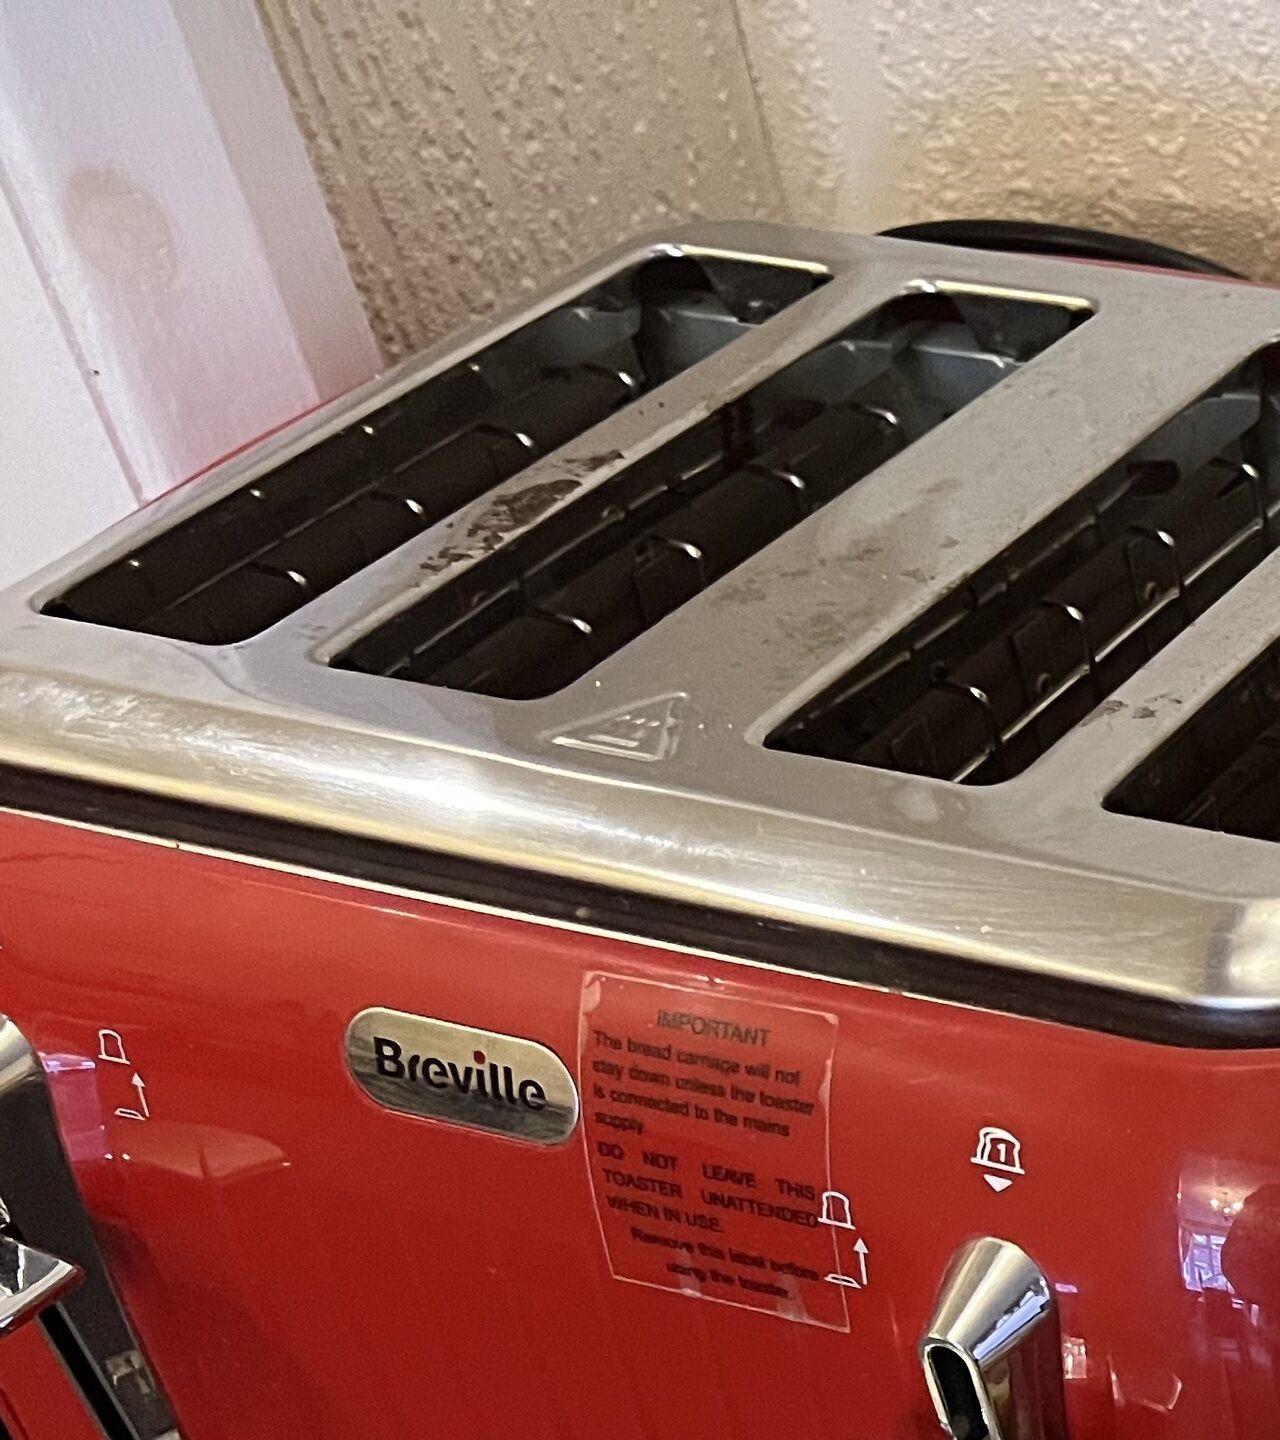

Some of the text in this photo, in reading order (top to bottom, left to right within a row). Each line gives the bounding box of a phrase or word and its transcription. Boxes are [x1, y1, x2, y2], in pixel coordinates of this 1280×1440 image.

[656, 1009, 771, 1047] IMPORTANT
[373, 1036, 547, 1110] Breville
[593, 1030, 801, 1086] The bread carriage will not
[592, 1060, 815, 1117] stay down unless the toaster
[610, 1090, 690, 1117] connected
[694, 1105, 709, 1121] to
[714, 1108, 738, 1127] the
[743, 1116, 790, 1137] mains
[597, 1140, 816, 1201] DO NOT LEAVE THIS
[602, 1168, 819, 1228] TOASTER UNATTENDED
[606, 1195, 659, 1220] WHEN
[664, 1206, 681, 1224] IN
